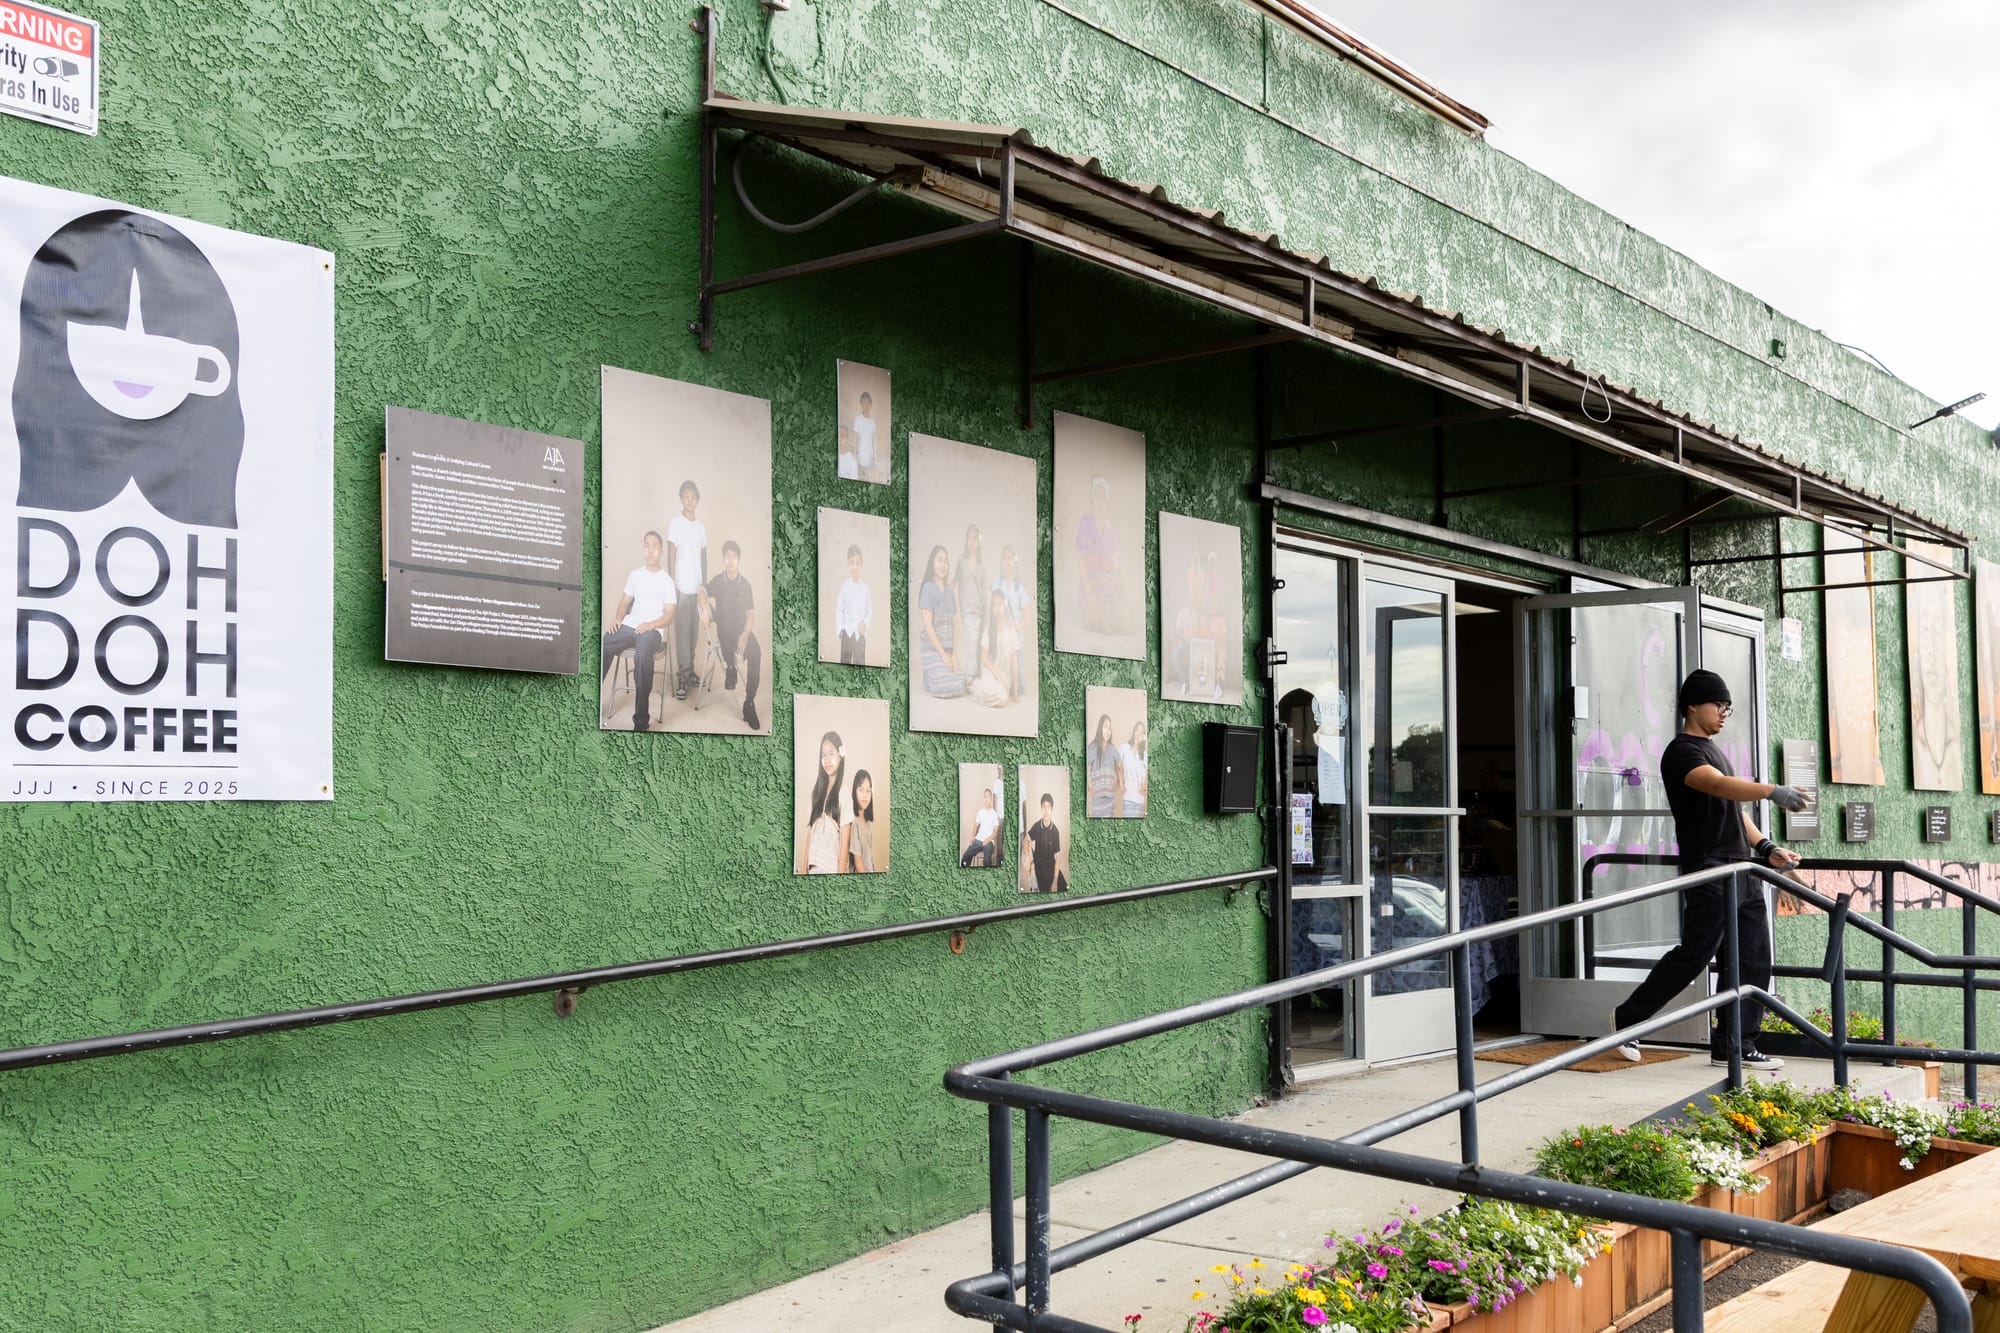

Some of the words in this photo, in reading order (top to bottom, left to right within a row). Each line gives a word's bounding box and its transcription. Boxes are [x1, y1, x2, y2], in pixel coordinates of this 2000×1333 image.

[0, 6, 83, 51] RNING
[32, 80, 46, 105] In
[52, 85, 80, 114] Use
[543, 446, 565, 466] AJA
[16, 516, 238, 613] DOH
[16, 608, 238, 698] DOH
[14, 703, 238, 753] COFFEE
[13, 781, 54, 795] JJJ
[96, 781, 169, 795] SINCE
[183, 781, 239, 795] 2025
